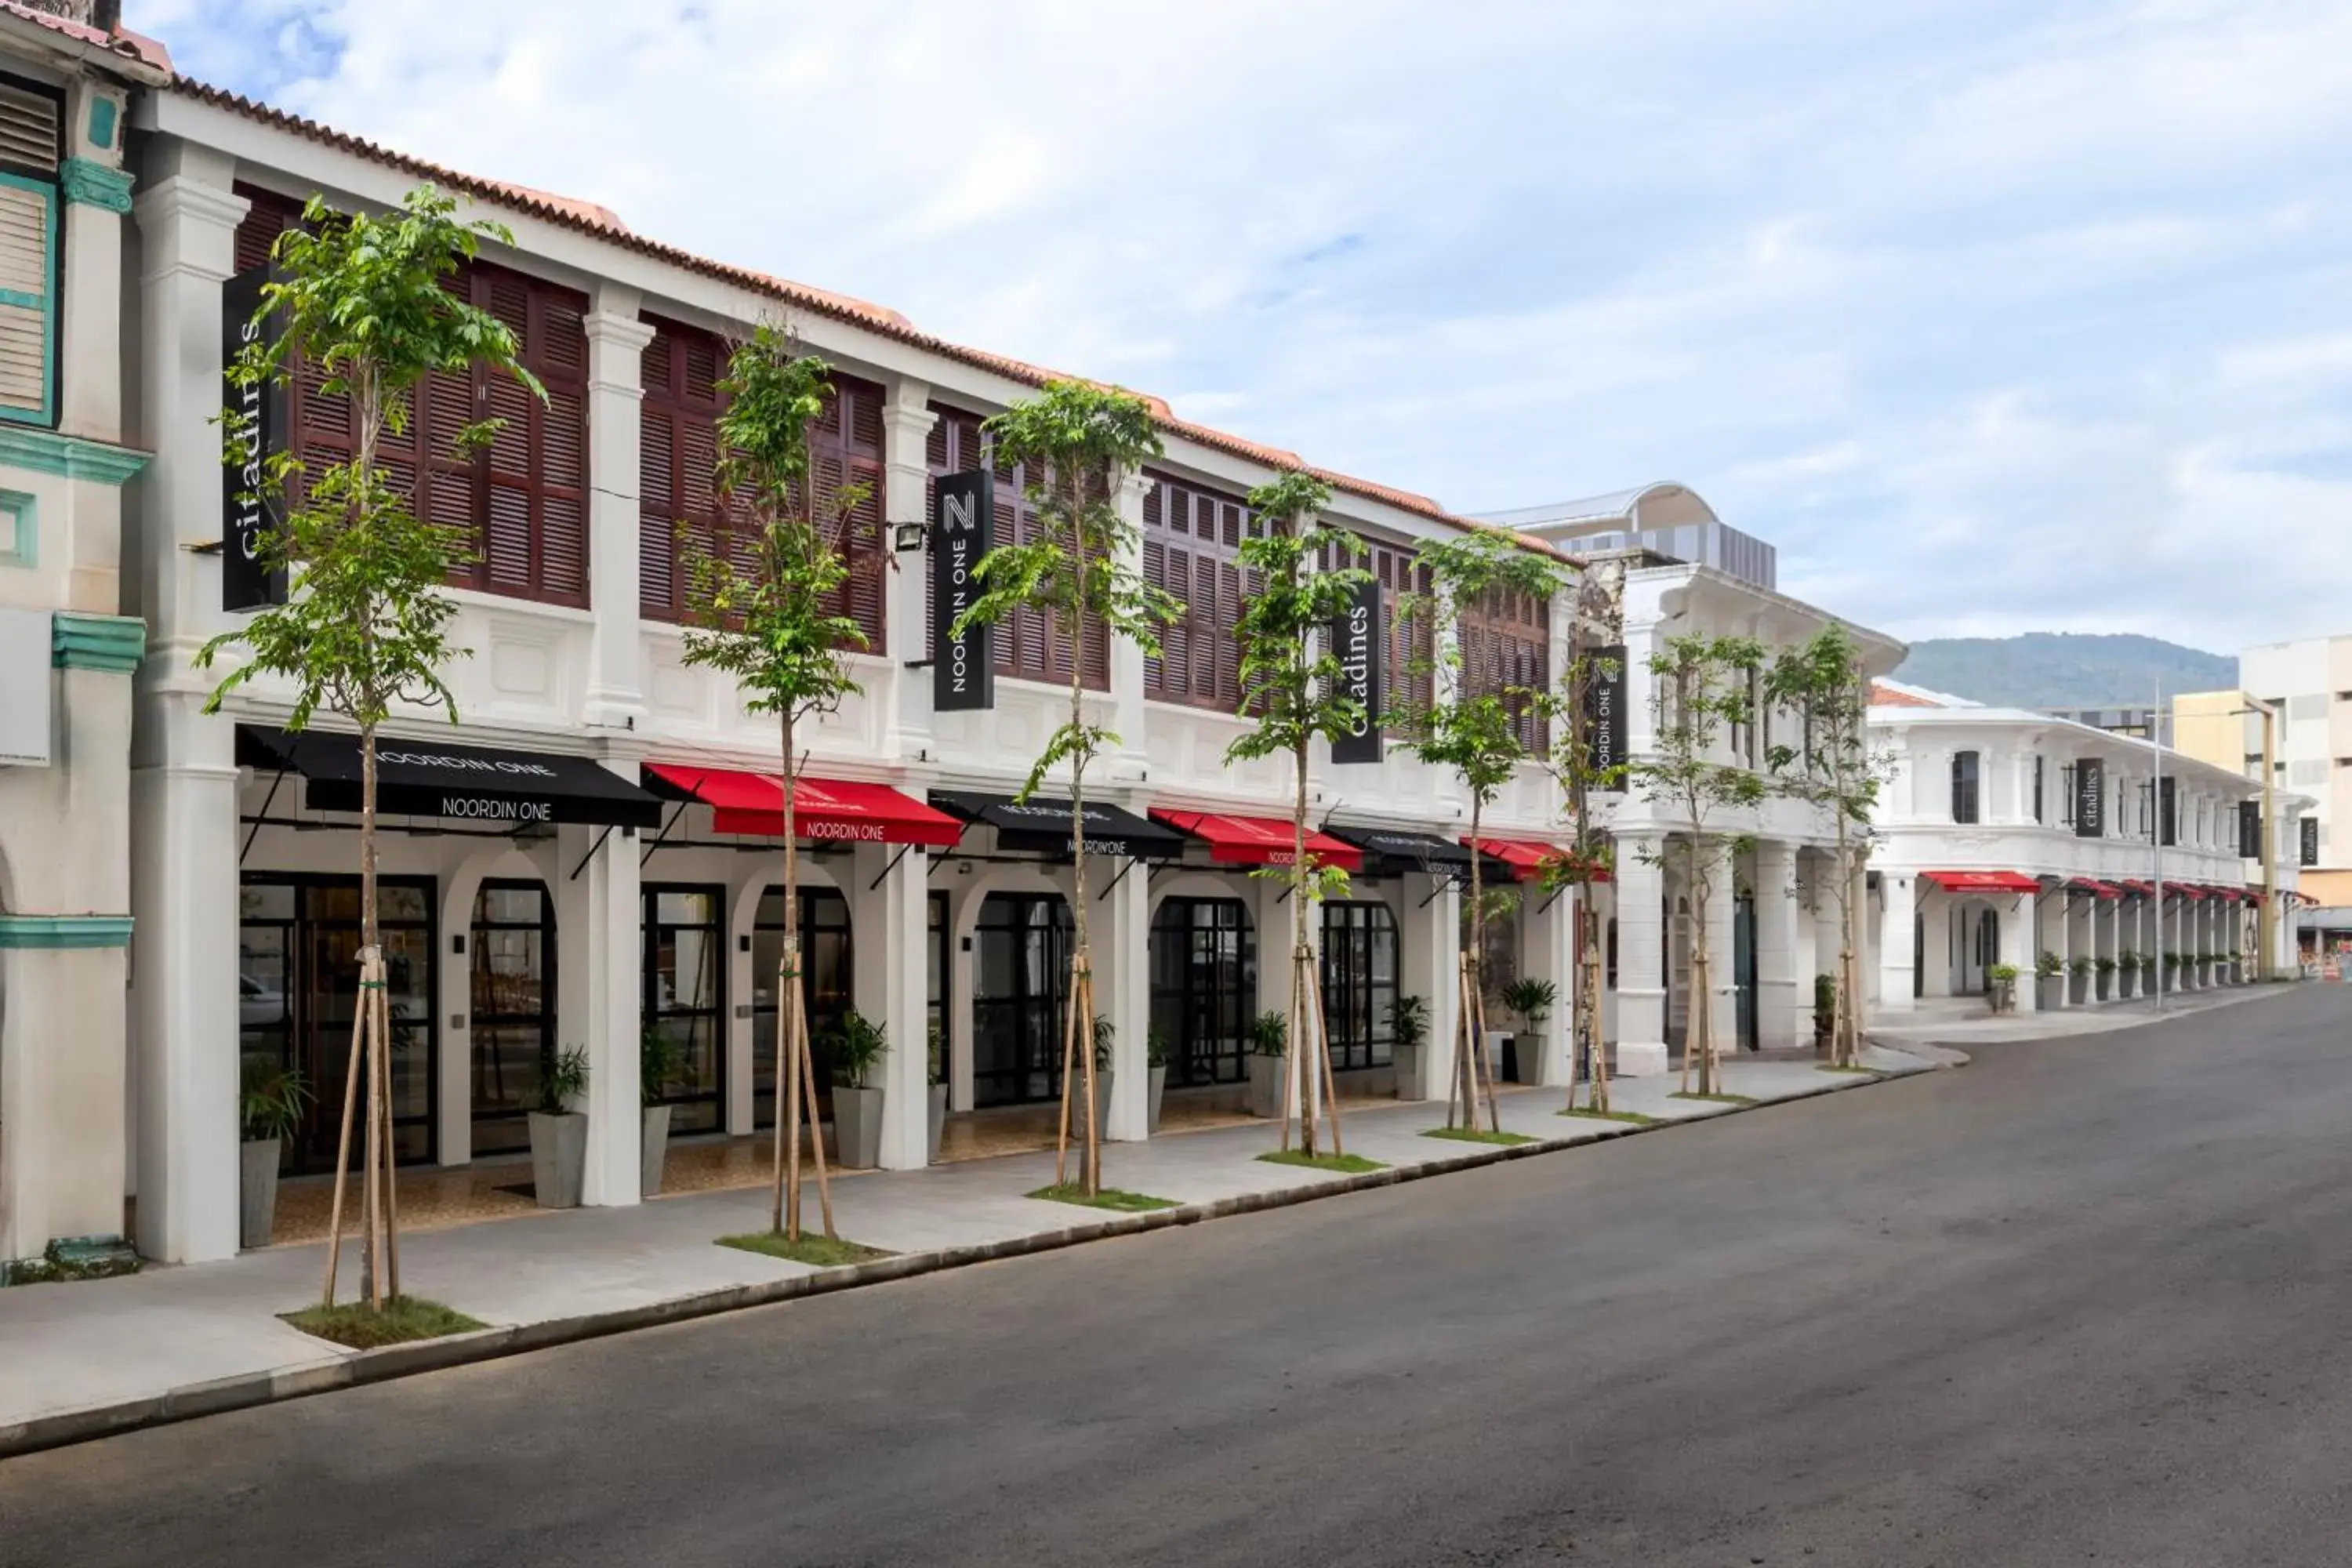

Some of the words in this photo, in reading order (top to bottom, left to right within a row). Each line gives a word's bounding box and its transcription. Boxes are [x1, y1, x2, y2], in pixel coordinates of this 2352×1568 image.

[953, 539, 966, 585] ONE
[1342, 606, 1367, 737] ctadines
[1599, 688, 1610, 716] ONE
[1599, 720, 1610, 773] OORDIN
[495, 760, 557, 777] ONE
[443, 797, 517, 818] NOORDIN
[520, 802, 551, 821] ONE
[807, 822, 859, 840] NOORDIN
[861, 825, 884, 841] ONE
[1067, 839, 1107, 853] NORDIN
